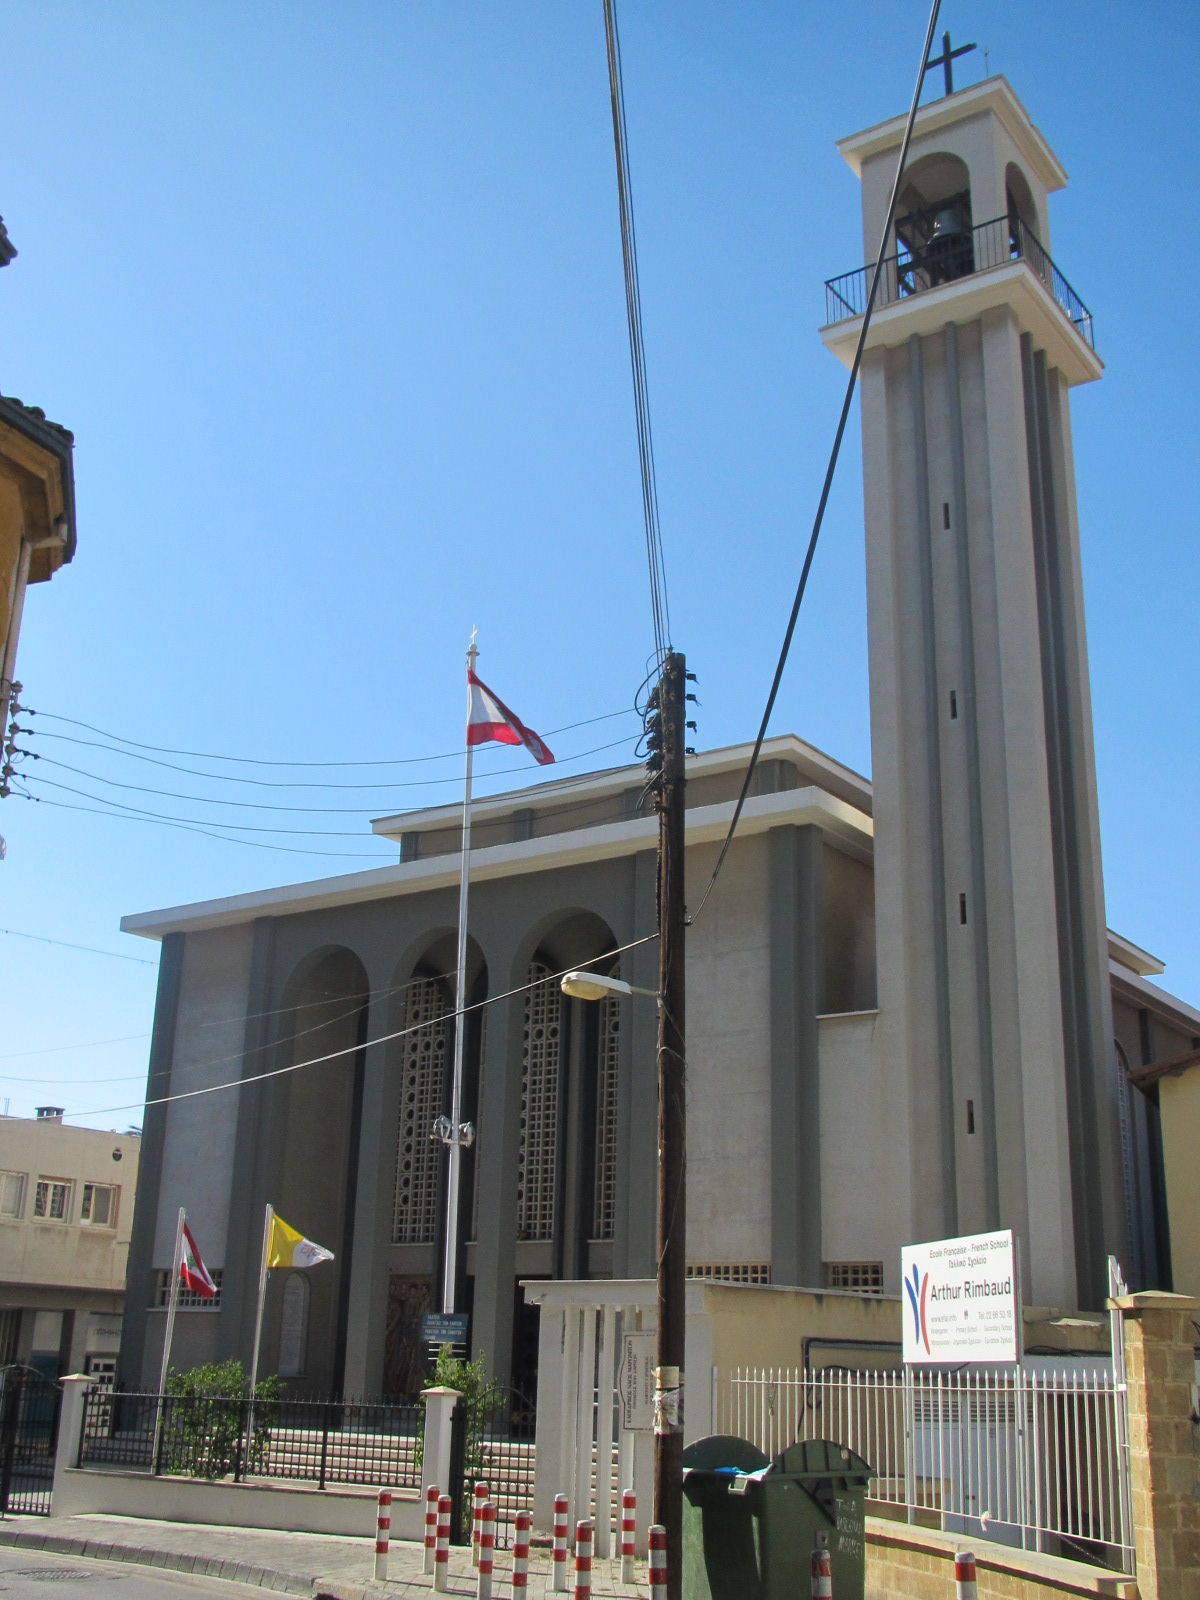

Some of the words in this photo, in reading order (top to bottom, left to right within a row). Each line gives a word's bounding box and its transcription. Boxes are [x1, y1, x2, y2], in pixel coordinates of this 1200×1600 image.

[971, 1242, 989, 1252] French
[990, 1239, 1009, 1250] School
[930, 1283, 962, 1302] Arthur
[964, 1276, 1011, 1298] Rimbaud
